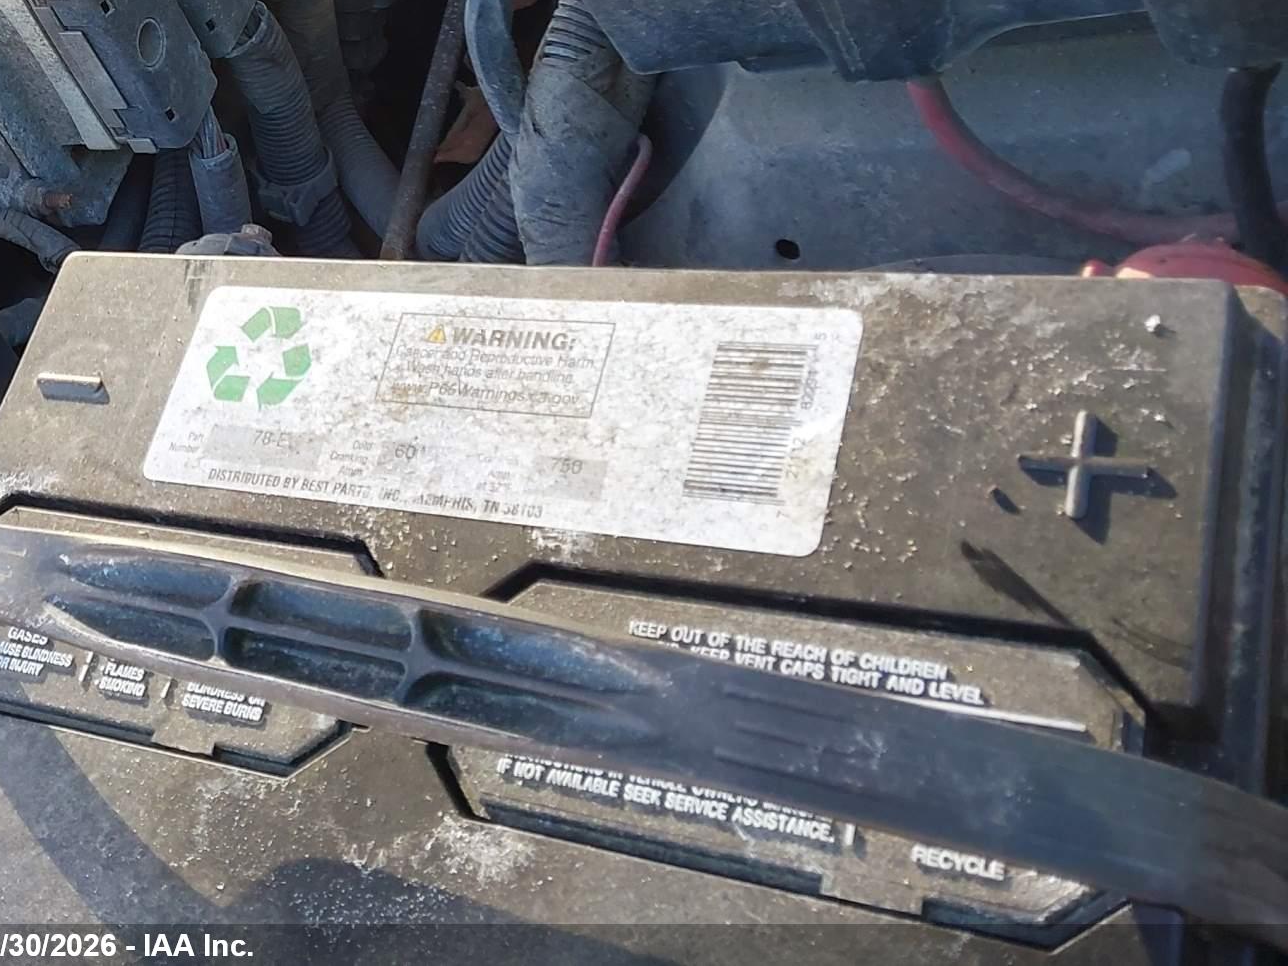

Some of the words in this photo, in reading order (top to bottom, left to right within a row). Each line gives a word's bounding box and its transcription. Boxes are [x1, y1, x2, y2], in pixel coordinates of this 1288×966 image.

[451, 326, 577, 351] WARNING:
[208, 467, 279, 488] DISTRIBUTED
[282, 477, 298, 490] BY
[302, 480, 330, 493] BEST
[482, 499, 501, 513] TN
[21, 645, 74, 668] BLINDNESS
[628, 620, 668, 640] KEEP
[670, 625, 705, 645] OUT
[707, 632, 732, 648] OF
[734, 635, 768, 655] THE
[770, 640, 827, 665] REACH
[830, 648, 856, 666] OF
[858, 652, 949, 681] CHILDREN
[9, 658, 44, 676] INJURY
[104, 661, 145, 682] FLAMES
[733, 652, 776, 672] VENT
[779, 658, 825, 682] CAPS
[830, 665, 883, 689] TIGHT
[885, 673, 926, 697] AND
[927, 679, 986, 707] LEVEL
[98, 676, 146, 697] SMOKING
[181, 694, 225, 714] SEVERE
[223, 701, 263, 722] BURNS
[496, 757, 513, 775] IF
[513, 762, 546, 782] NOT
[545, 768, 621, 798] AVAILABLE
[623, 782, 663, 807] SEEK
[664, 791, 730, 822] SERVICE
[730, 805, 837, 844] ASSISTANCE.
[912, 844, 1004, 880] RECYCLE
